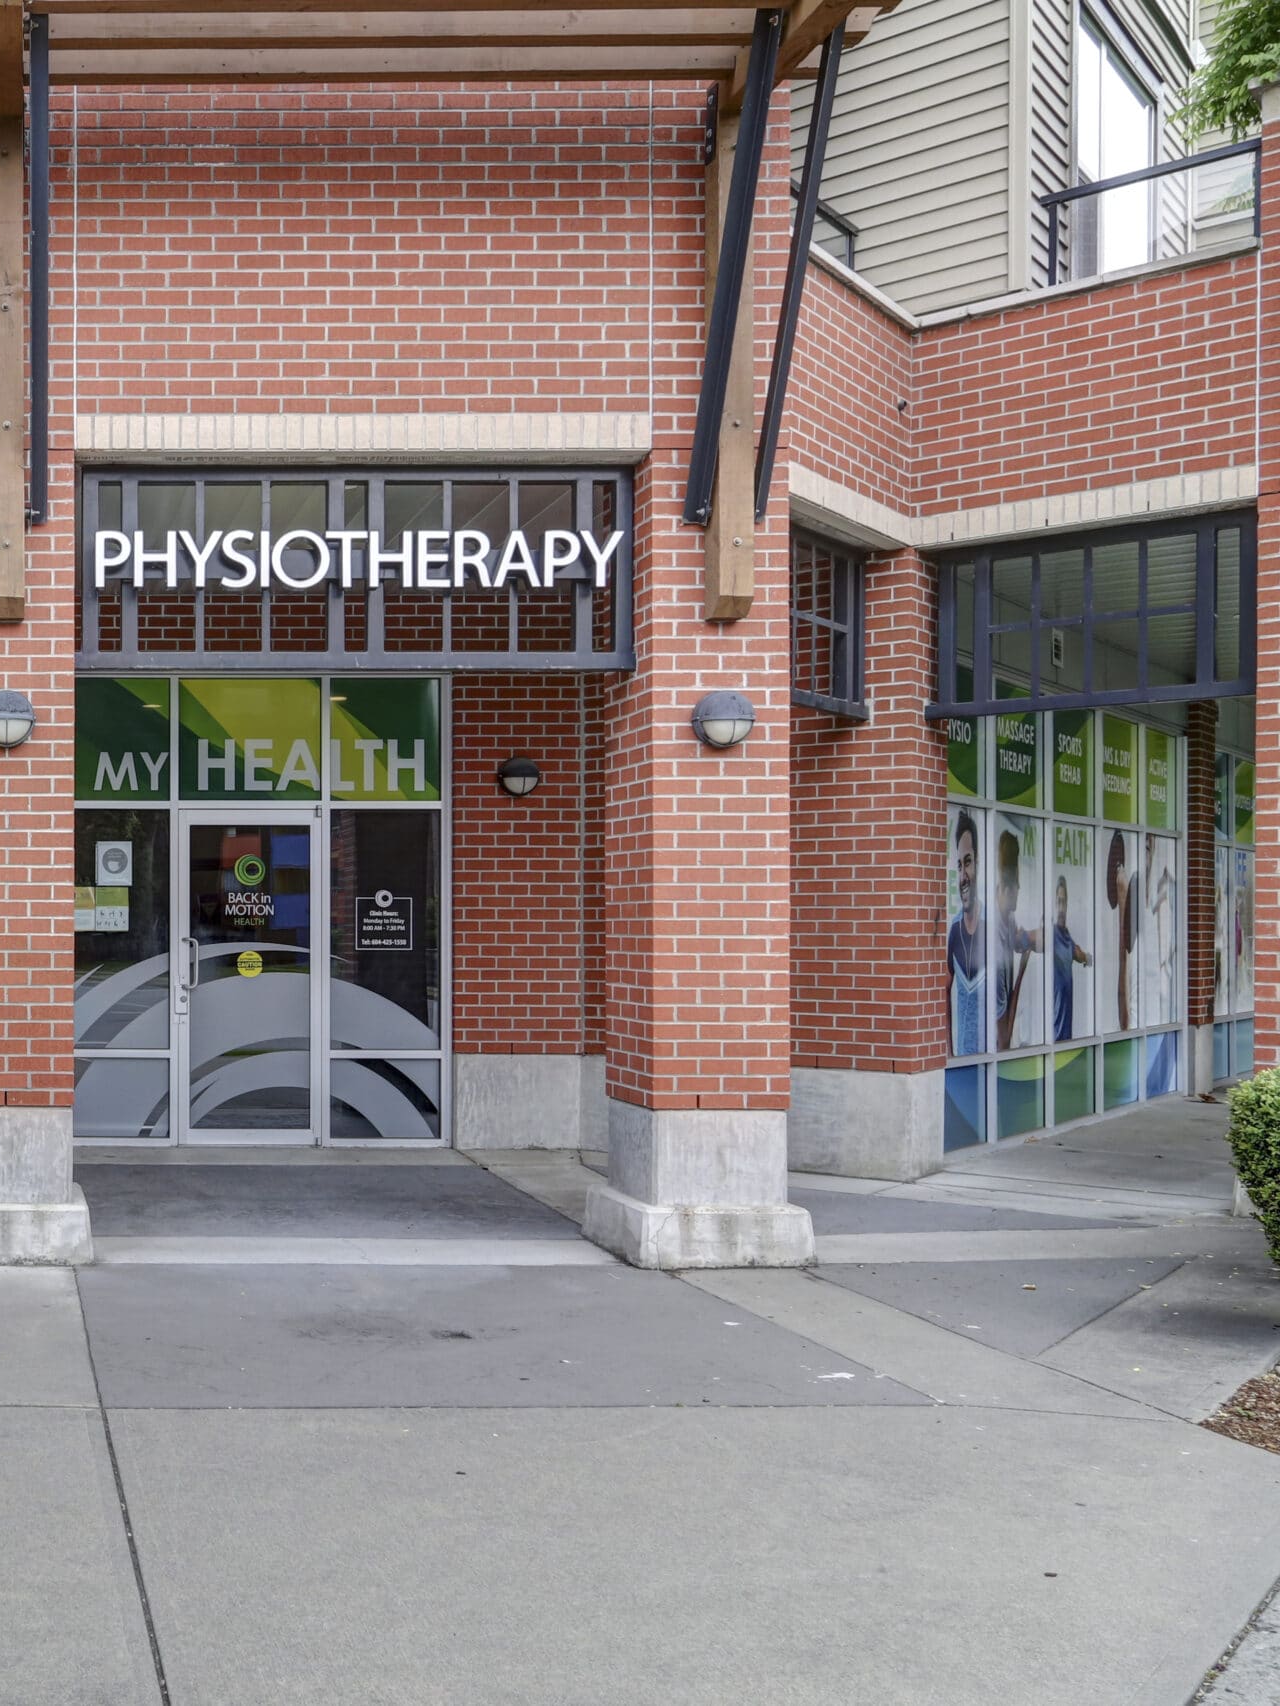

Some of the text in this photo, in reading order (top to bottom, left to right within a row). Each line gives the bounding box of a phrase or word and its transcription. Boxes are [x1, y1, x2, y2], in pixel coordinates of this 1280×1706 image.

[93, 529, 625, 589] PHYSIOTHERAPY
[997, 717, 1035, 745] MASSAGE
[1058, 733, 1082, 757] SPORTS
[93, 738, 425, 791] MY HEALTH
[1000, 749, 1032, 775] THERAPY
[1060, 763, 1081, 785] REHAB
[224, 904, 275, 916] MOTION
[228, 892, 271, 904] BACK in
[233, 917, 265, 926] HEALTH
